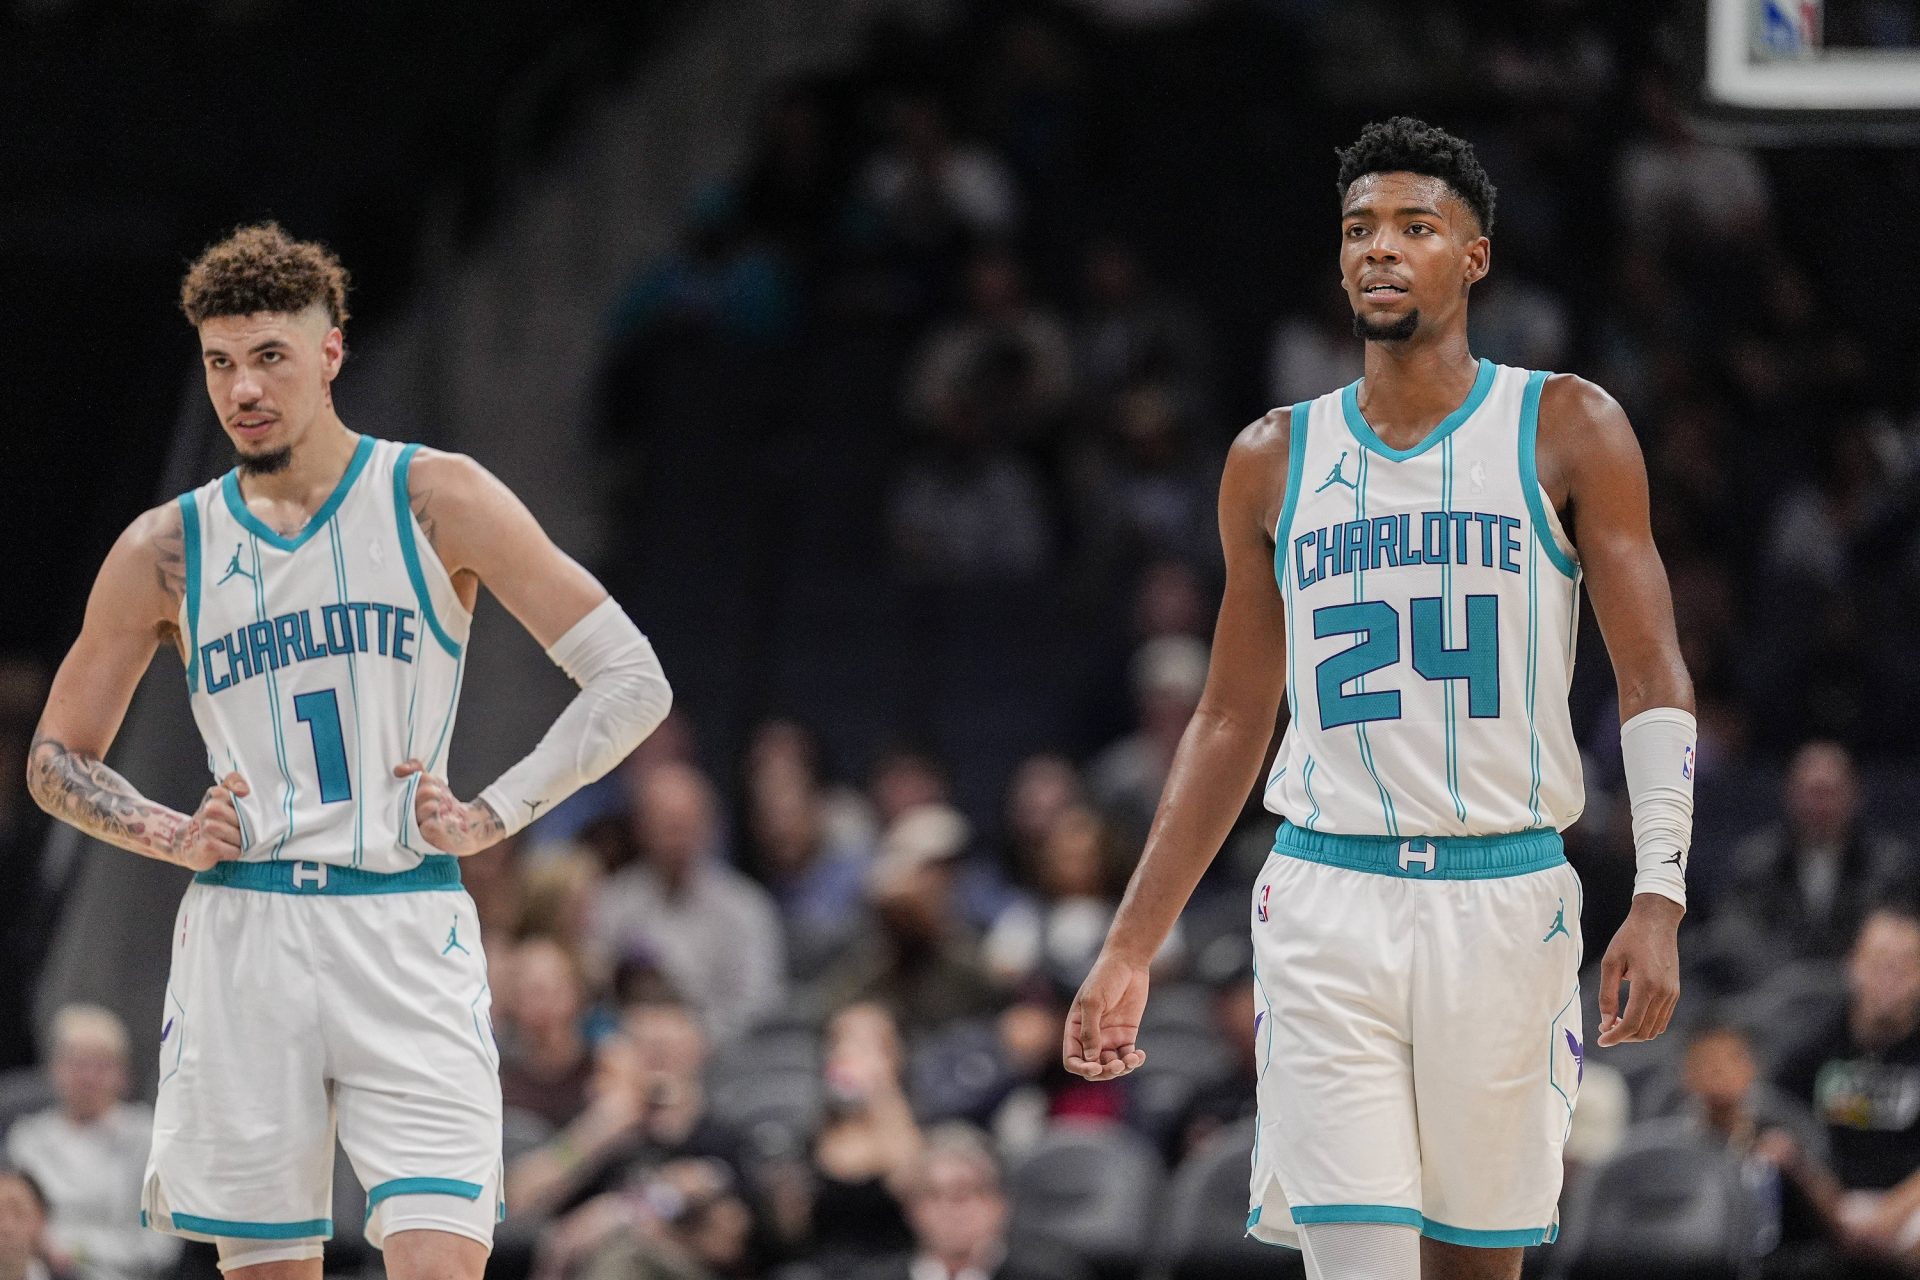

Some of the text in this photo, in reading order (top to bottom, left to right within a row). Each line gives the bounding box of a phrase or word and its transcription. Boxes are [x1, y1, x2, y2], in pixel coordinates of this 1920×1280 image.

[1294, 511, 1522, 591] CHARLOTTE
[200, 602, 415, 696] CHARLOTTE
[1312, 594, 1500, 731] 24
[293, 687, 352, 805] 1
[292, 861, 328, 891] H
[1397, 839, 1437, 873] H
